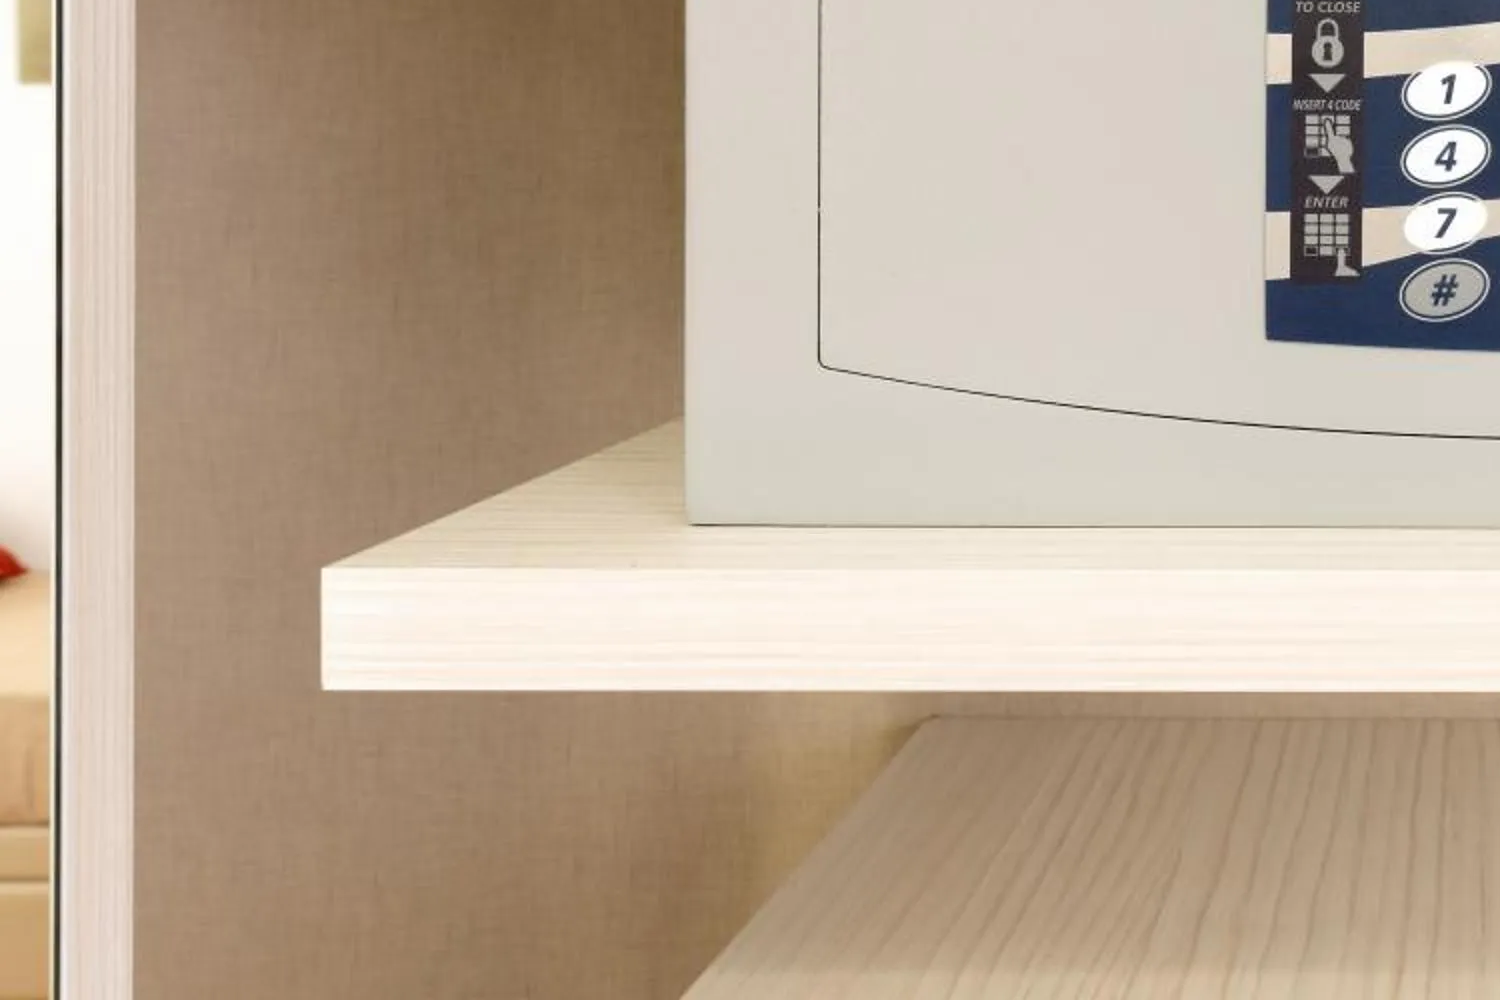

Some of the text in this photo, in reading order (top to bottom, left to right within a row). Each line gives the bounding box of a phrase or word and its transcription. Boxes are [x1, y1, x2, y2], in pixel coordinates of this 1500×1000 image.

[1296, 1, 1361, 14] TO CLOSE
[1441, 74, 1457, 105] 1
[1293, 99, 1326, 110] INSERT
[1336, 99, 1361, 111] CODE
[1435, 142, 1457, 172] 4
[1305, 197, 1348, 208] ENTER
[1435, 208, 1458, 239] 7
[1432, 275, 1458, 306] #
